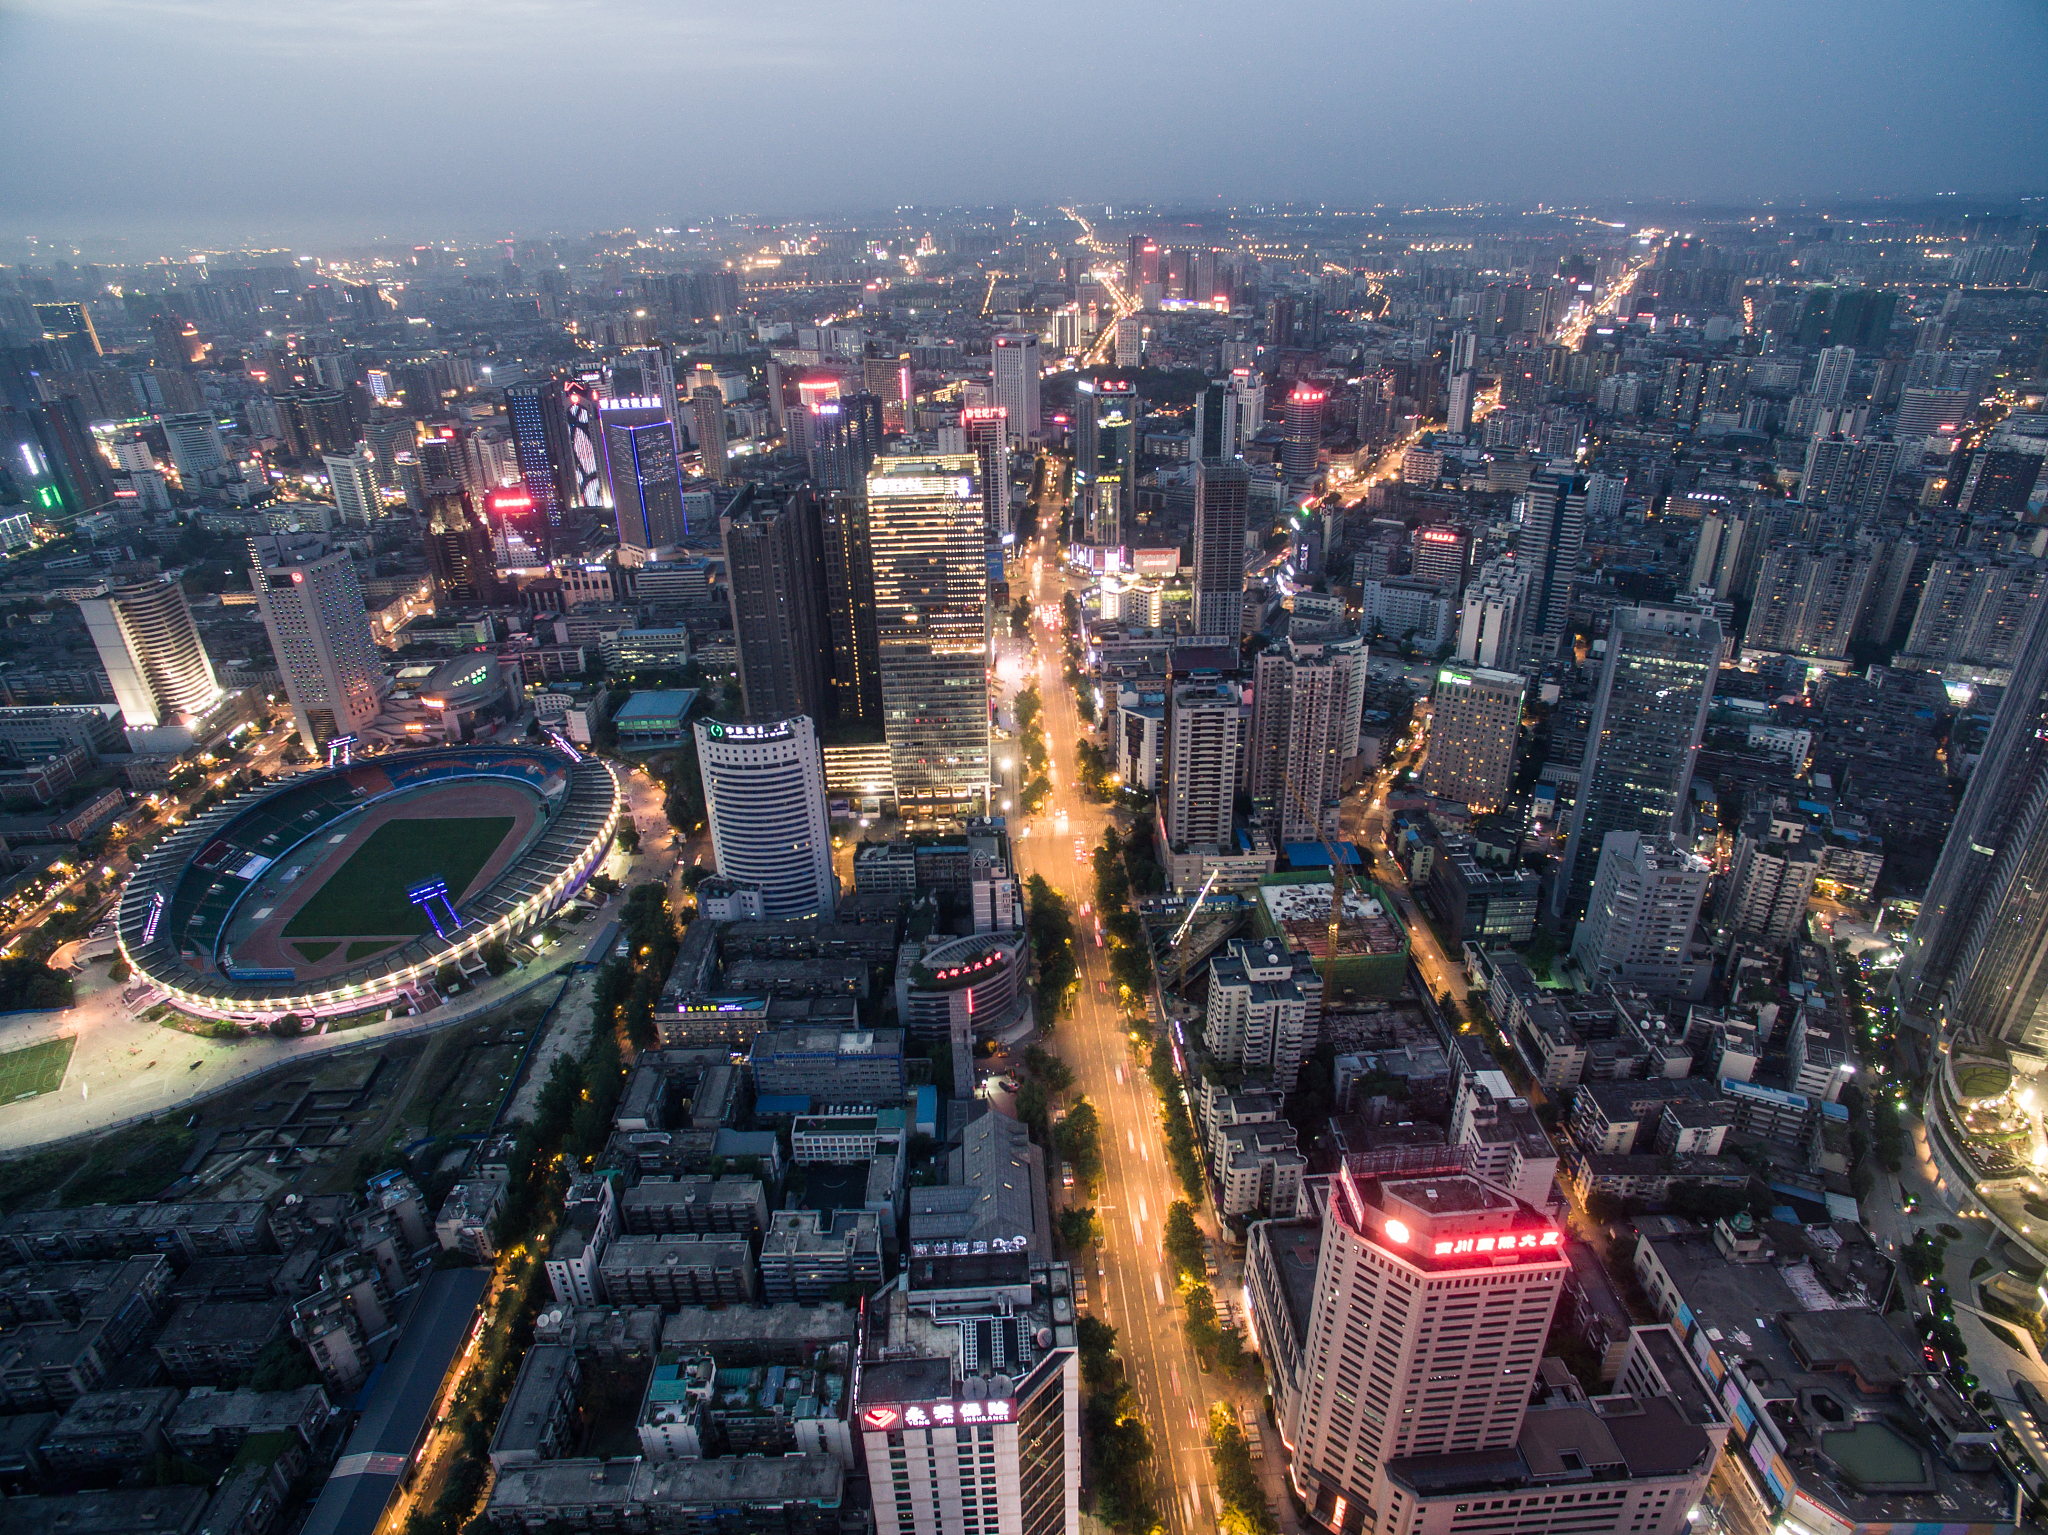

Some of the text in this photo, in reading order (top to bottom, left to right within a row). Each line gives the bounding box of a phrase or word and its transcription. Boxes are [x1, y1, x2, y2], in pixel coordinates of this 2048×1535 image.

[1434, 1231, 1559, 1255] 四川国际大厦
[905, 1401, 1010, 1421] 永安保险
[908, 1419, 931, 1427] YONG
[963, 1415, 1009, 1423] INSURANCE
